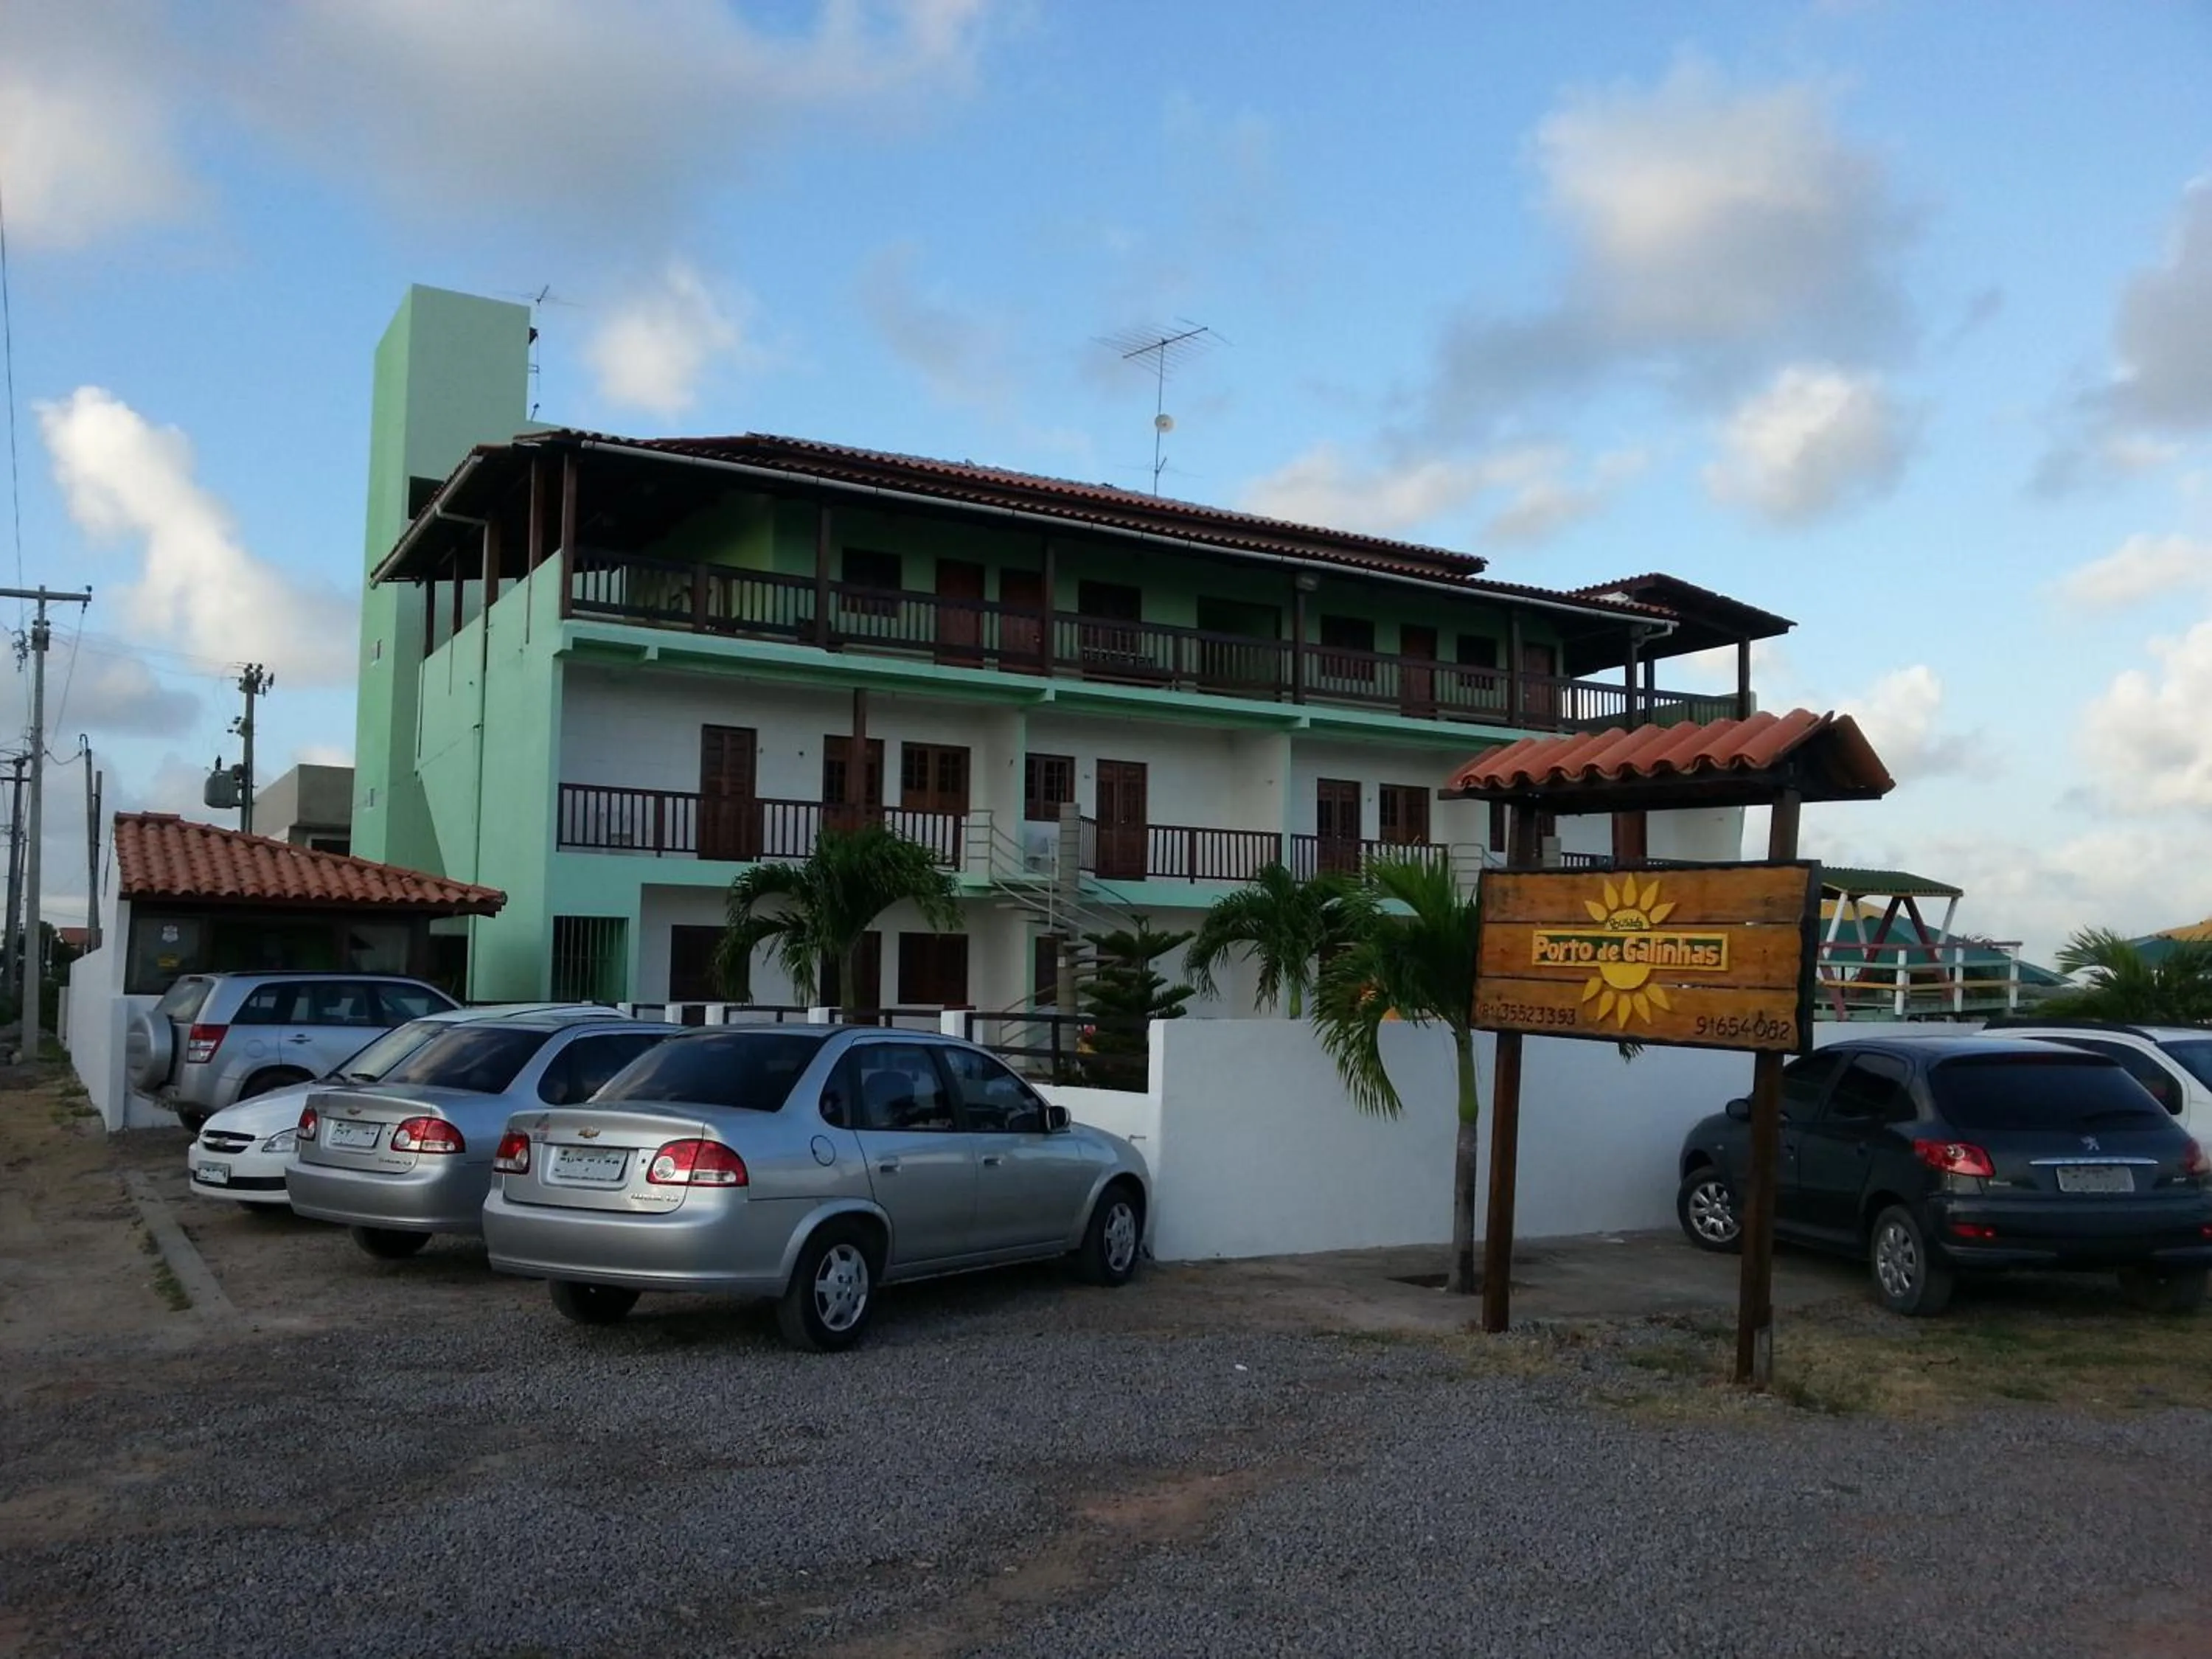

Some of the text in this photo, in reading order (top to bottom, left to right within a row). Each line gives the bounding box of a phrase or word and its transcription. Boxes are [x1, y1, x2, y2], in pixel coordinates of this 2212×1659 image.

[1534, 935, 1722, 966] Porto de Galinhas
